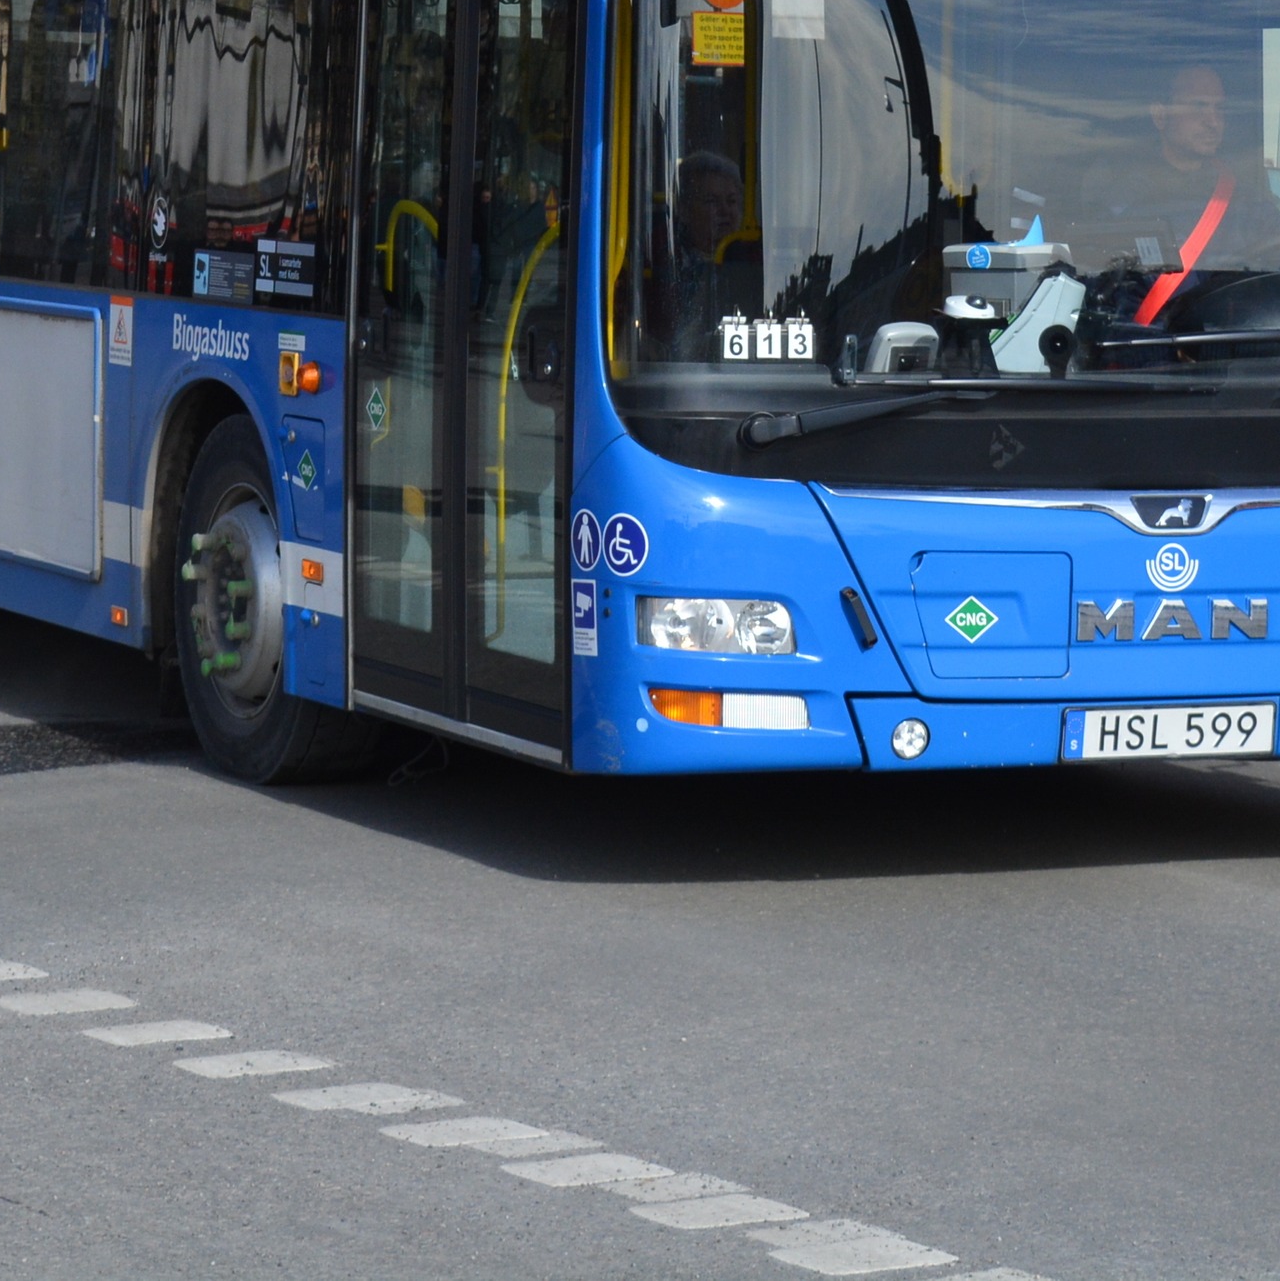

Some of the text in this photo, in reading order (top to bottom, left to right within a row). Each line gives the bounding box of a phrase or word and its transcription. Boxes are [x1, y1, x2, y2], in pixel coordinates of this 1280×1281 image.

[260, 254, 271, 278] SL
[172, 312, 250, 362] Biogasbuss
[370, 402, 382, 416] CNG
[301, 463, 312, 477] CNG
[1161, 552, 1184, 572] SL
[956, 612, 987, 627] CNG
[1076, 598, 1269, 642] MAN
[1070, 711, 1258, 752] S HSL 599
